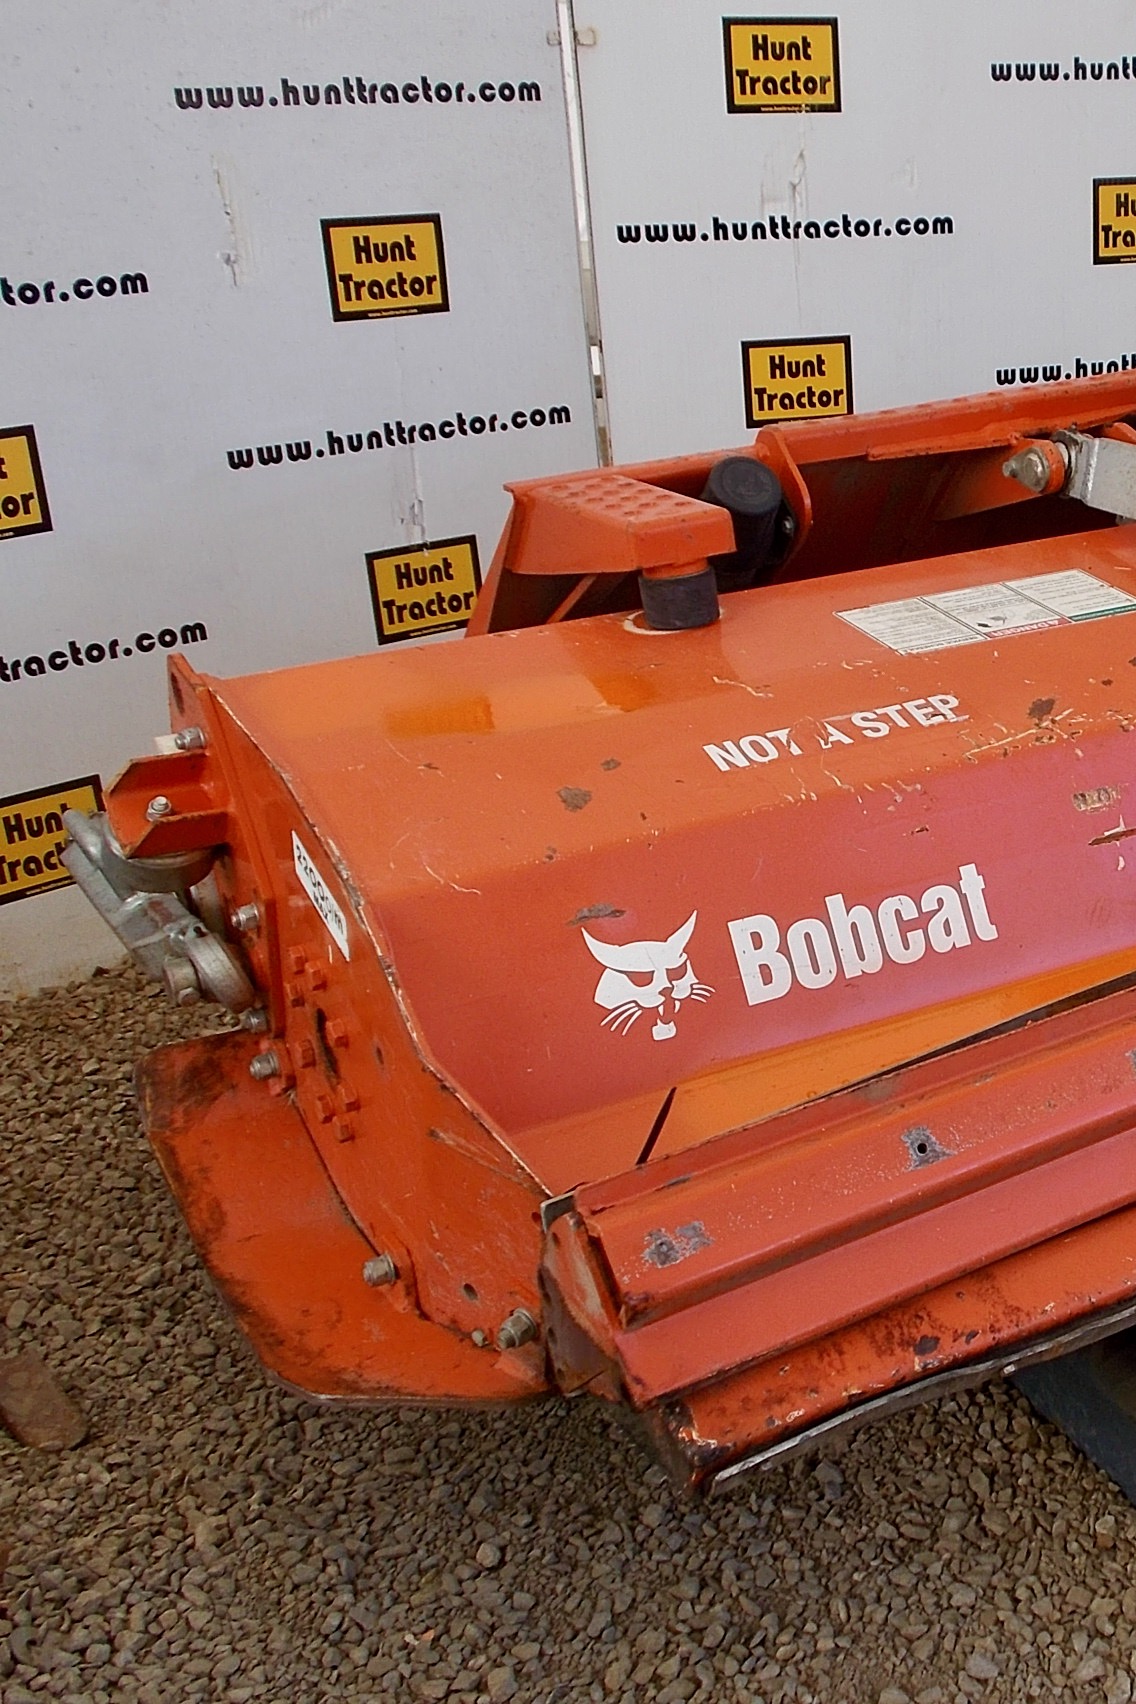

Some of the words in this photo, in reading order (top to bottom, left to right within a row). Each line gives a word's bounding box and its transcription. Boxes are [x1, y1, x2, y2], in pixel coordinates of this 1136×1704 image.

[751, 34, 812, 61] Hunt
[174, 75, 542, 110] www.hunttractor.com
[735, 67, 831, 97] Tractor
[616, 213, 954, 244] www.hunttractor.com
[352, 234, 416, 265] Hunt
[338, 271, 437, 302] Tractor
[769, 353, 826, 380] Hunt
[753, 385, 844, 412] Tractor
[226, 404, 572, 471] www.hunttractor.com
[394, 557, 454, 590] Hunt
[382, 589, 476, 627] Tractor
[702, 728, 805, 772] NOT
[819, 719, 854, 749] A
[851, 694, 970, 741] STEP
[727, 863, 998, 1006] Bobcat
